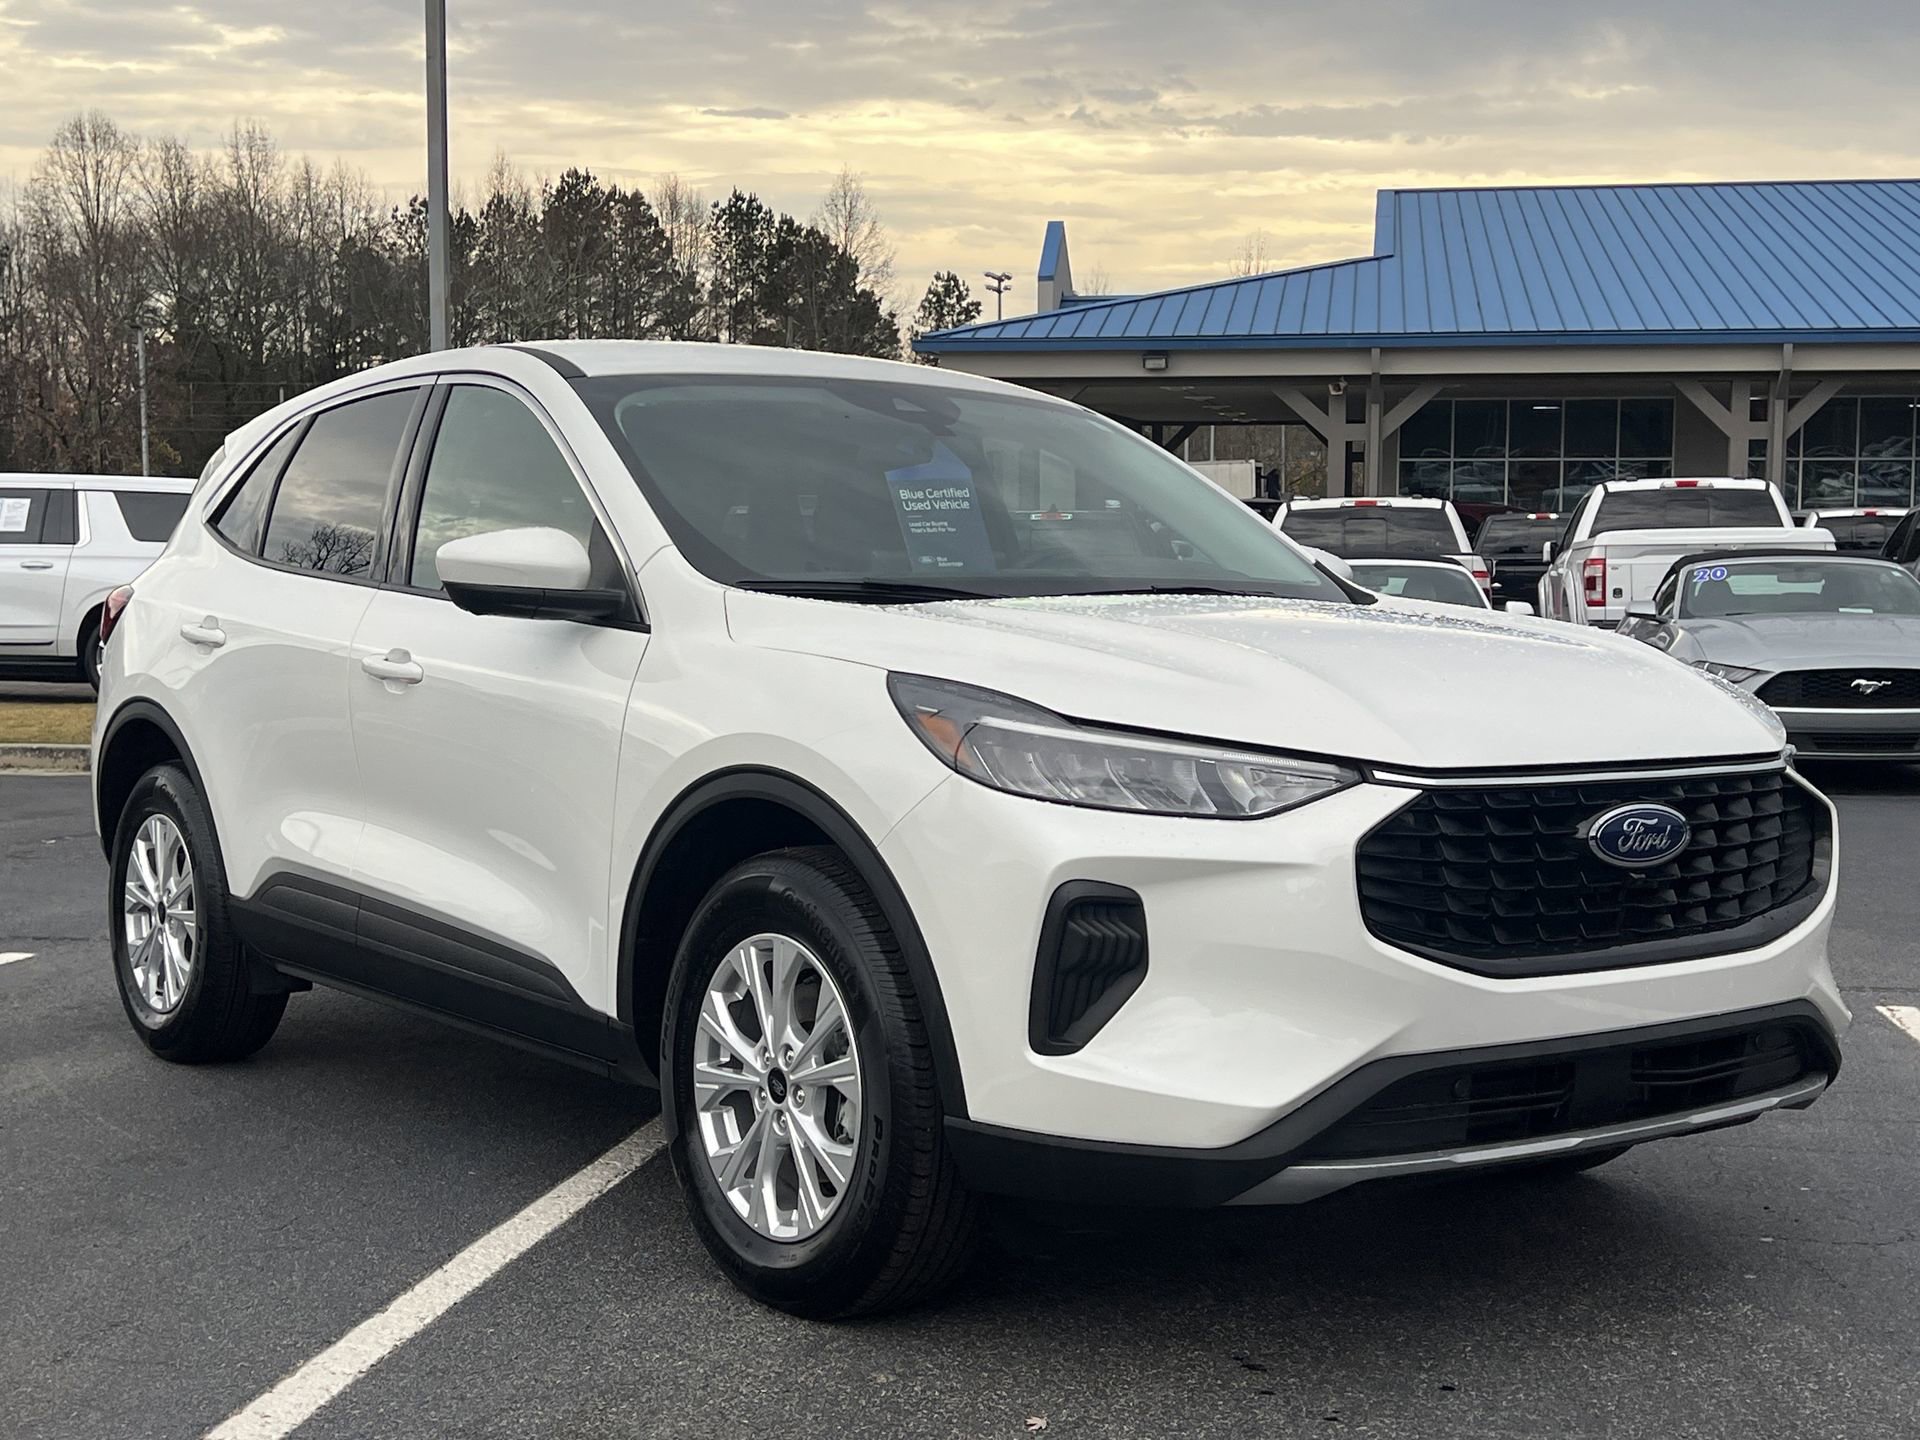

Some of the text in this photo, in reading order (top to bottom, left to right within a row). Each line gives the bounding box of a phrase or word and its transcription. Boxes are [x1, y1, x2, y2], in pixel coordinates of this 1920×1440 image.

[899, 487, 970, 500] Blue Certified
[902, 499, 970, 511] Used Vehicle
[1693, 566, 1727, 582] 20
[1617, 817, 1672, 853] Ford
